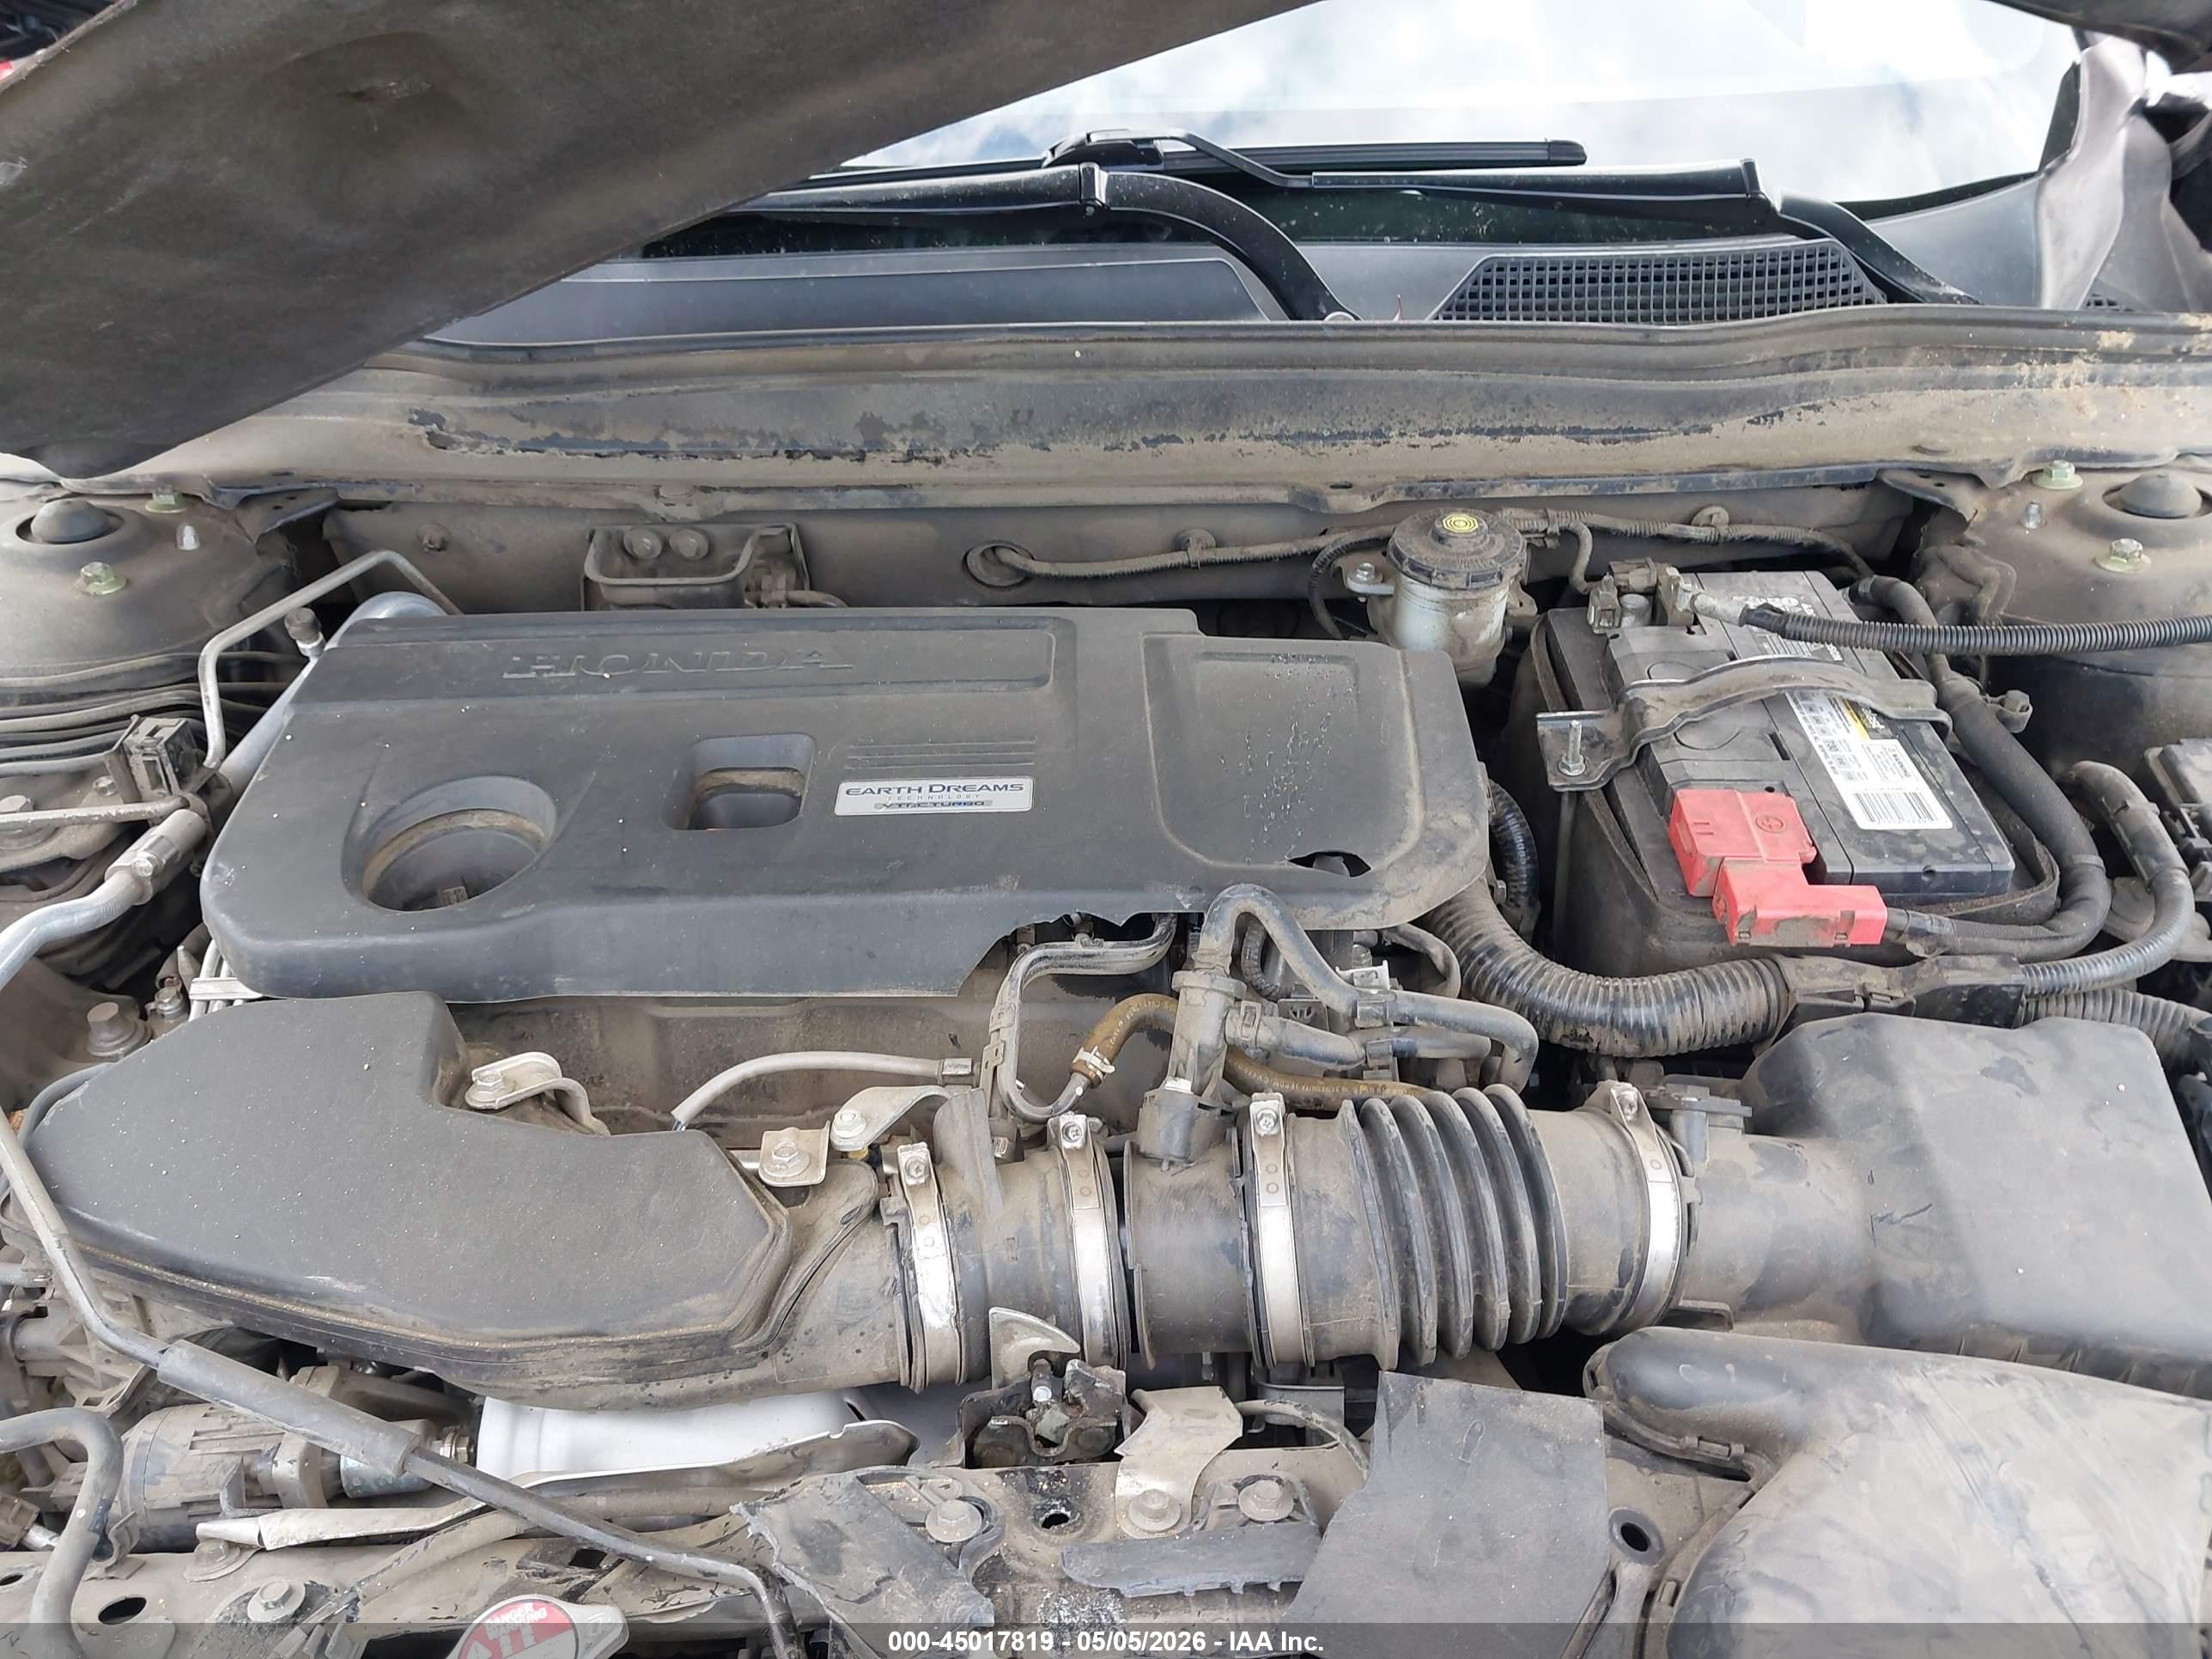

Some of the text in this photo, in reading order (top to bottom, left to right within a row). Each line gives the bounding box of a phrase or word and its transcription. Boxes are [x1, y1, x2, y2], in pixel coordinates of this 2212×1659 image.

[503, 650, 854, 679] HONDA
[845, 783, 1024, 796] EARTH DREAMS
[483, 1602, 535, 1630] DANGER
